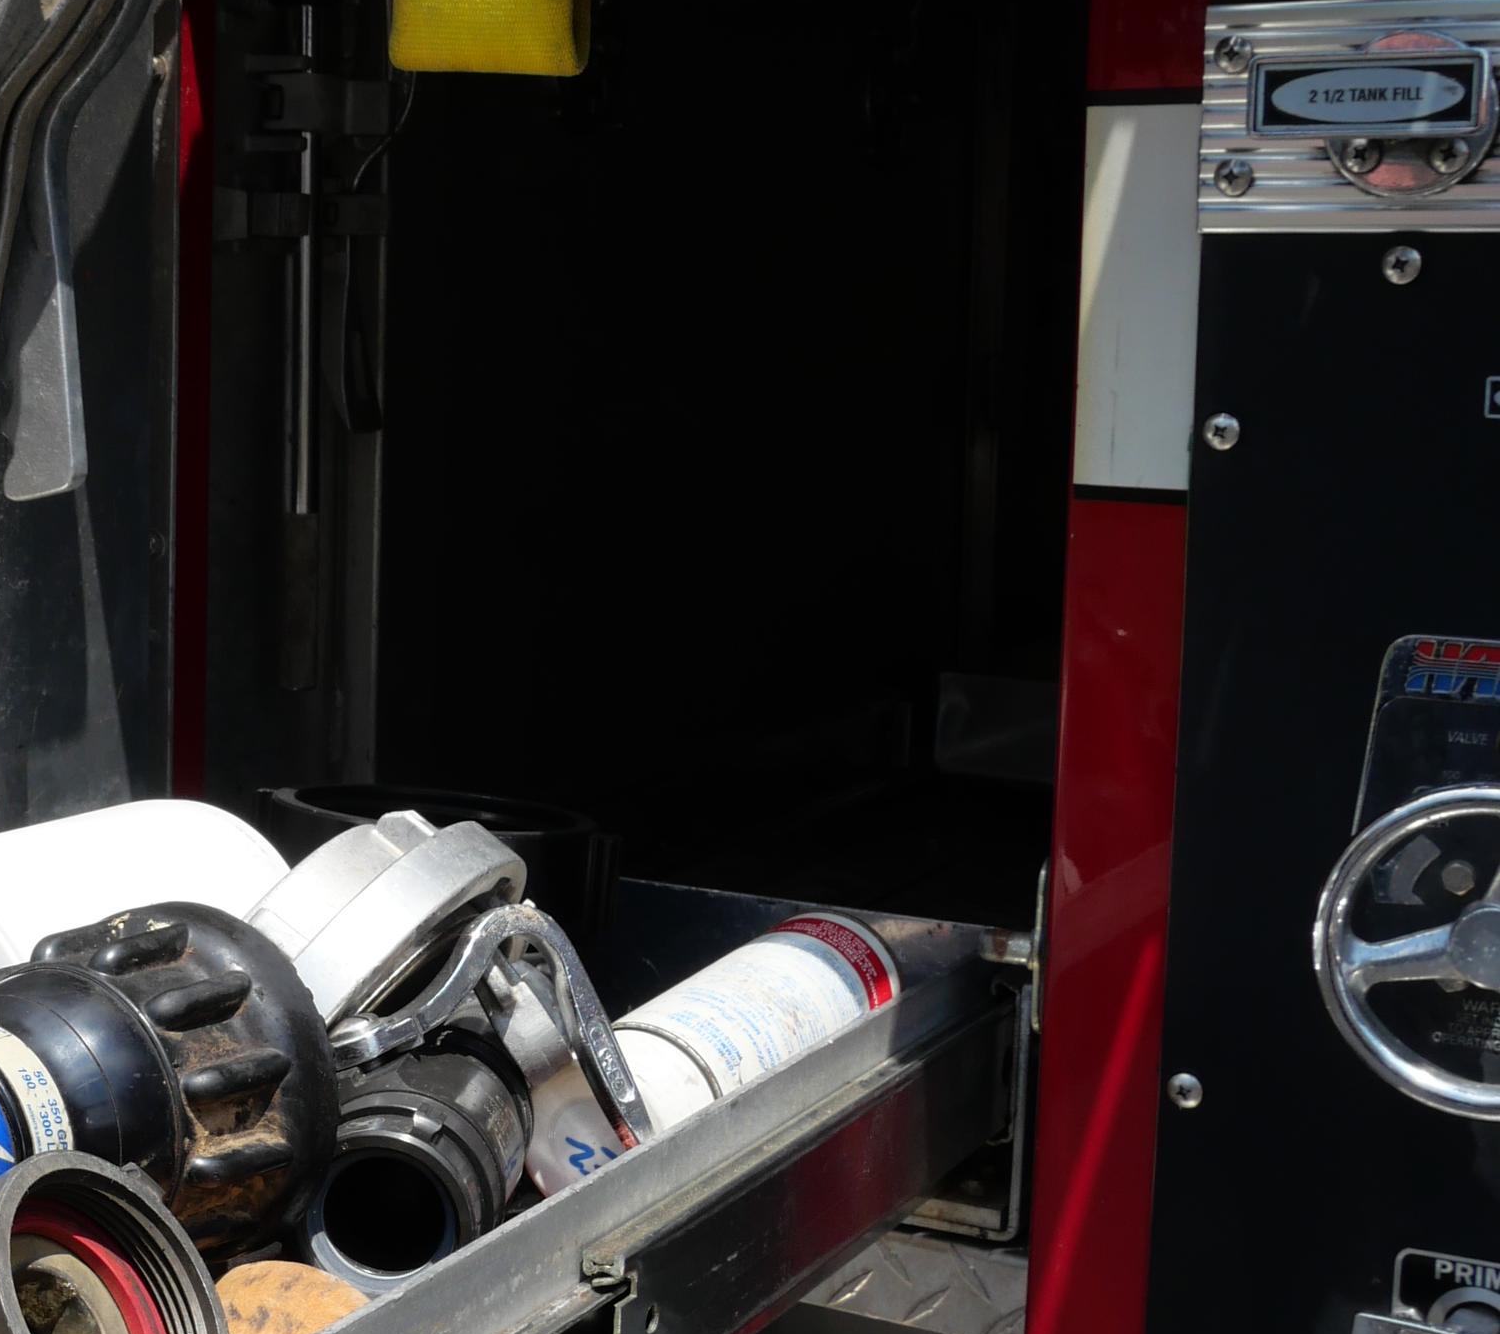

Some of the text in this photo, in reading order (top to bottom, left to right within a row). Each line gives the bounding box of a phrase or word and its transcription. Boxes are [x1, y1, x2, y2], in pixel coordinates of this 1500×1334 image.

[1308, 87, 1424, 103] 2 1/2 TANK FILL
[18, 1067, 37, 1090] 190
[33, 1070, 48, 1086] 50
[47, 1098, 63, 1124] 350
